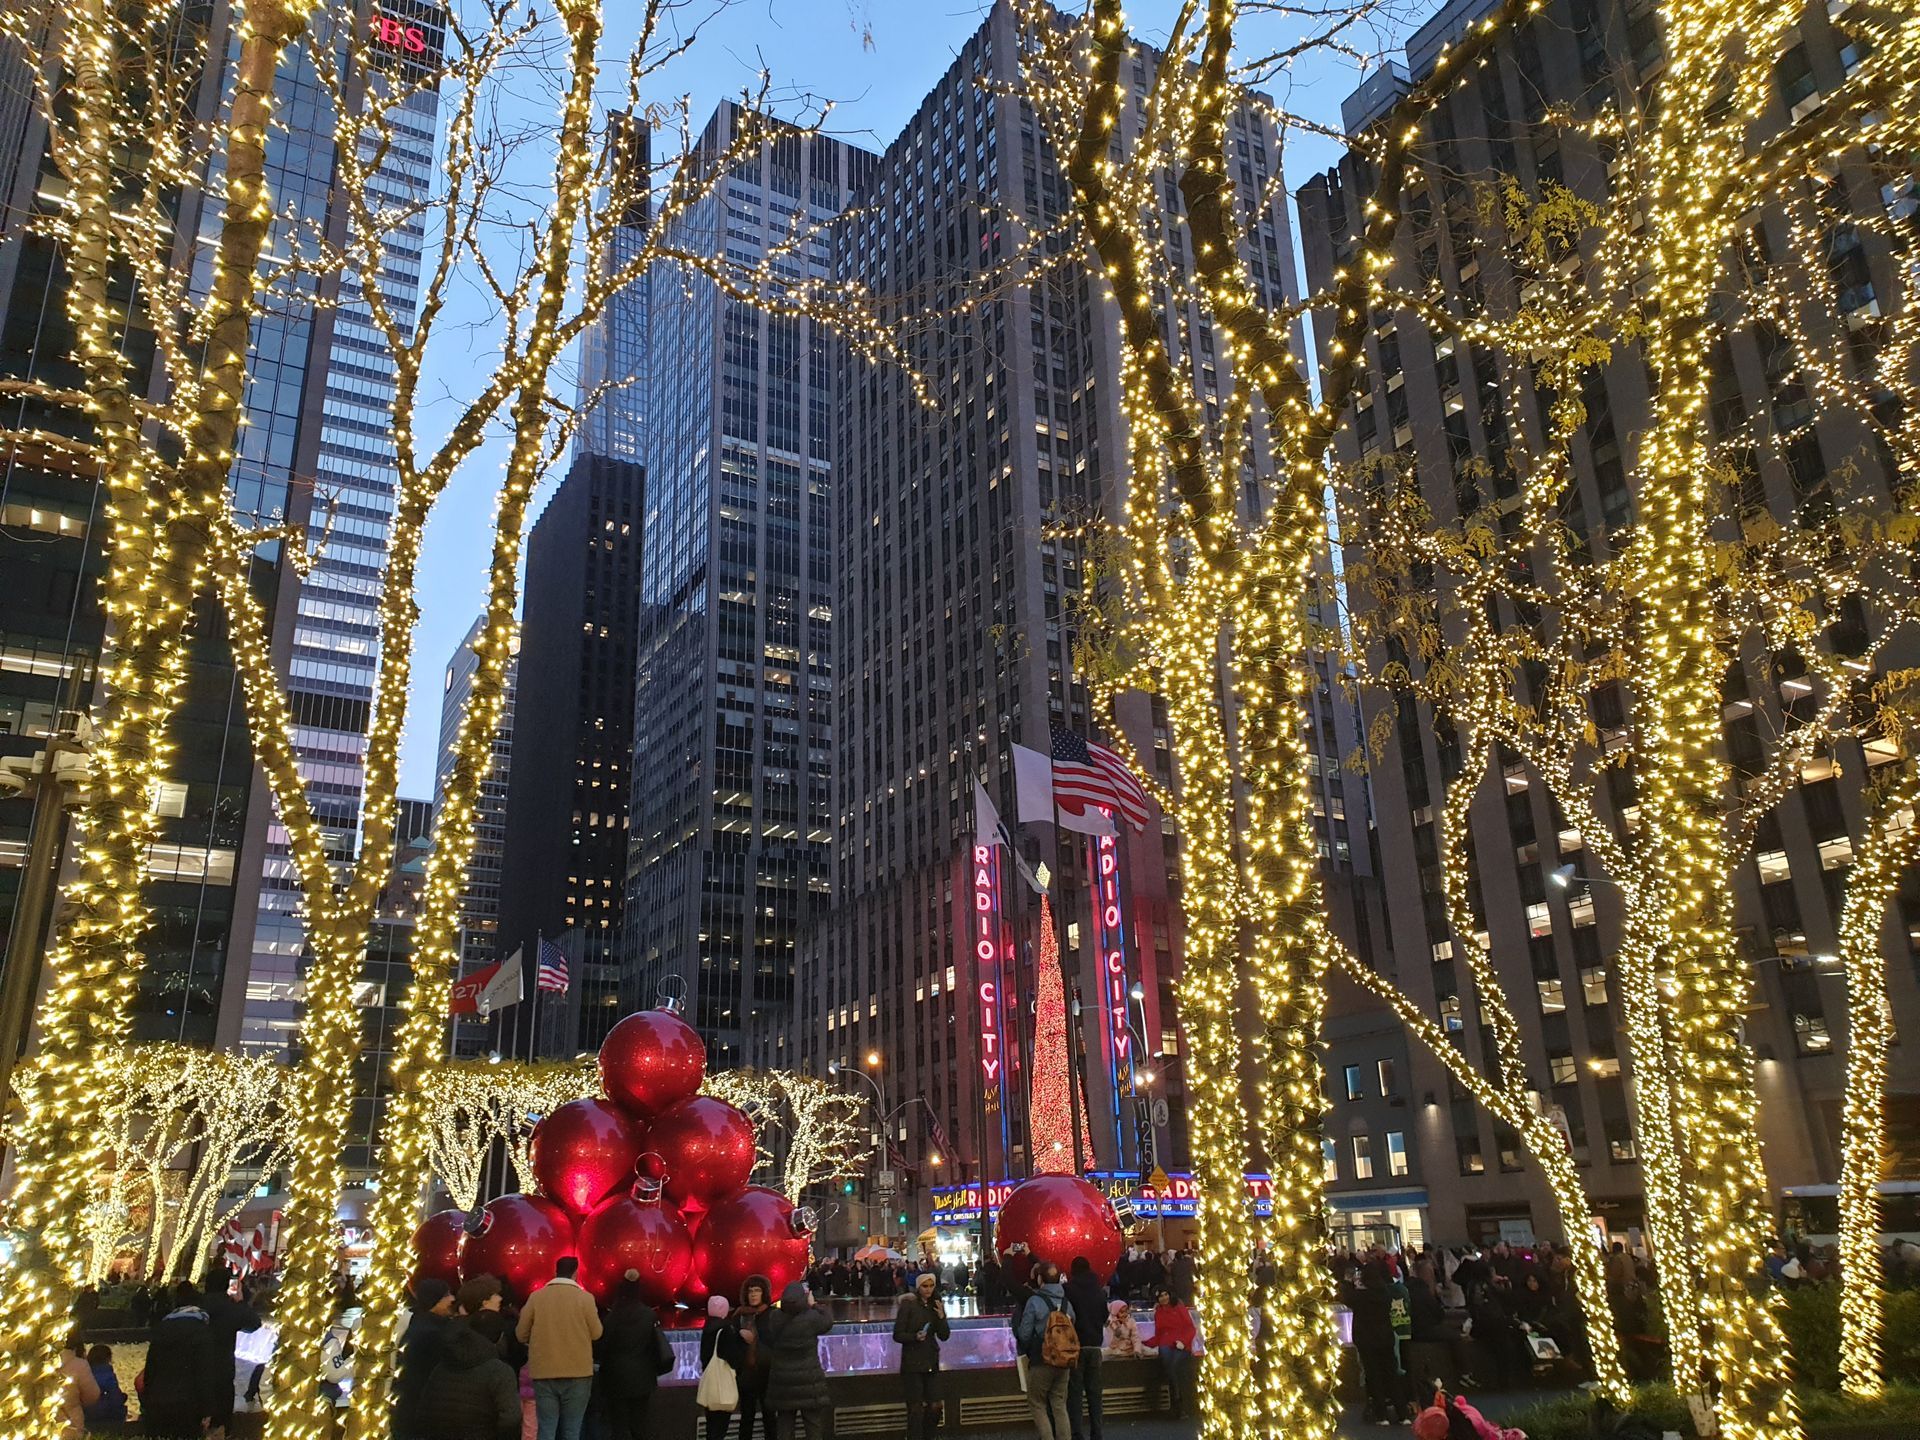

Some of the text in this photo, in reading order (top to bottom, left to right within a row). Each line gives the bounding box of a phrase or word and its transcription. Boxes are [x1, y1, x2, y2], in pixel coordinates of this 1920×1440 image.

[975, 845, 999, 1079] RADIO CITY
[1109, 951, 1128, 1058] CITY
[1142, 1181, 1199, 1198] RADI
